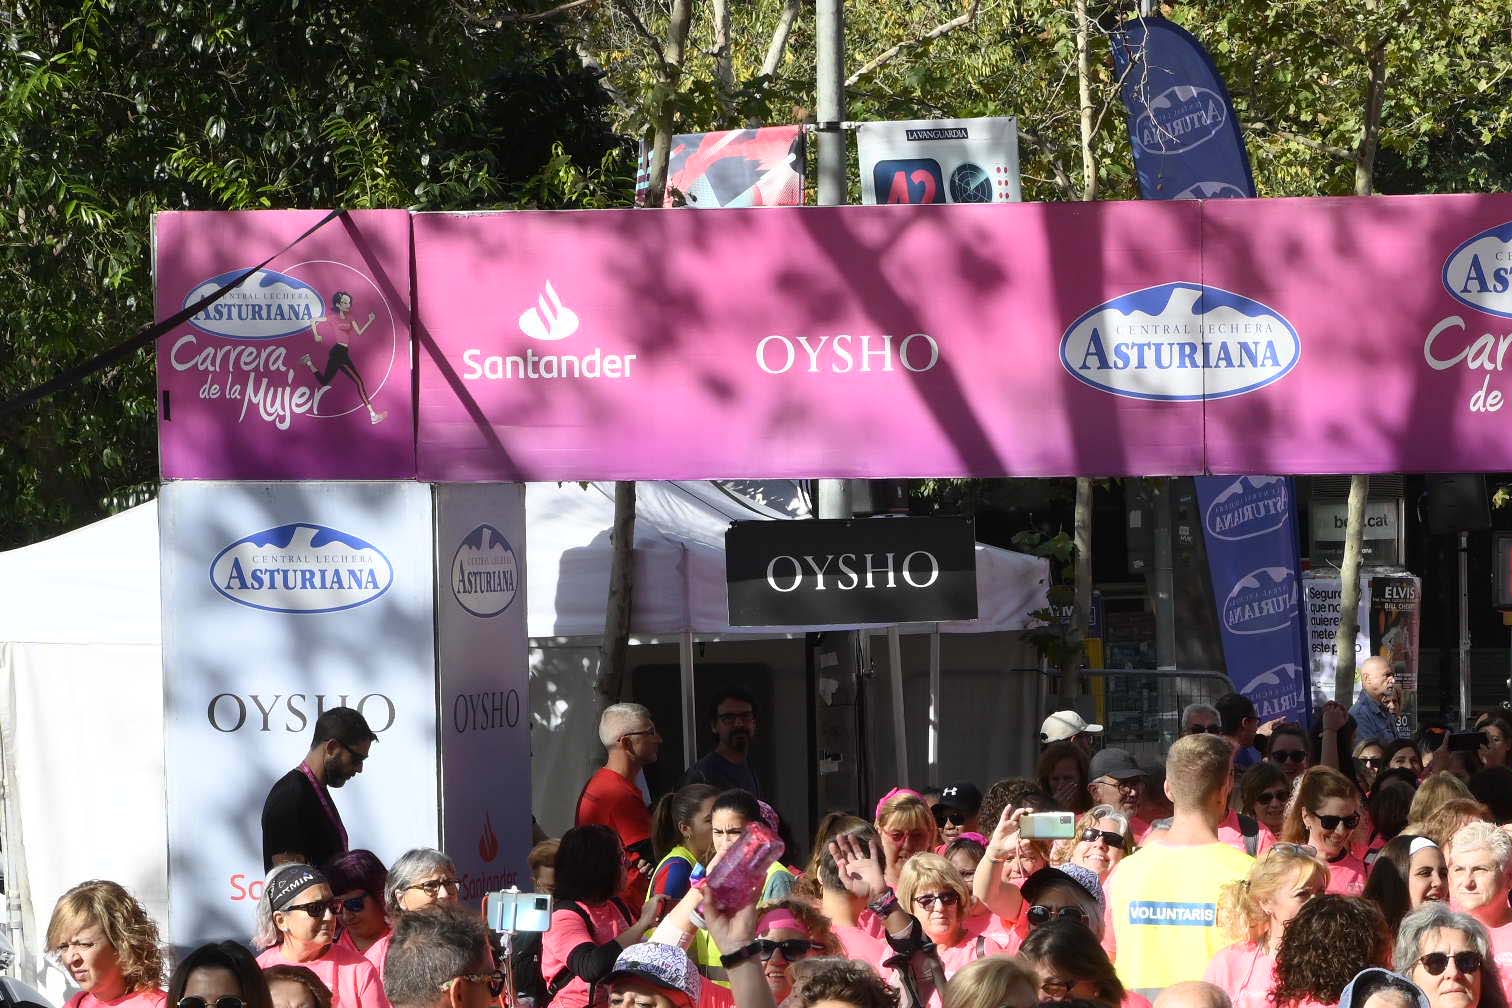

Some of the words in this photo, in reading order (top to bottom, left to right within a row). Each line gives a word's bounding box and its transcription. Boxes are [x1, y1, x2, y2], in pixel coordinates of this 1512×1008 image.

[918, 128, 968, 140] VANGUARDIA
[1116, 322, 1191, 336] CENTRAL
[1198, 322, 1273, 335] LECHERA
[171, 335, 288, 372] Carrera
[463, 347, 637, 381] Santander
[755, 333, 940, 374] OYSHO
[1079, 334, 1281, 370] ASTURIANA
[200, 375, 220, 400] de
[225, 373, 241, 399] la
[239, 368, 332, 430] Mujer
[1470, 374, 1507, 413] de
[224, 557, 381, 591] ASTURIANA
[252, 555, 311, 564] CENTRAL
[457, 558, 515, 595] ASTURIANA
[766, 550, 940, 593] OYSHO
[1385, 586, 1416, 599] ELVIS
[1311, 604, 1326, 616] que
[1312, 642, 1330, 653] este
[454, 688, 520, 735] OYSHO
[1130, 906, 1215, 923] VOLUNTARIS
